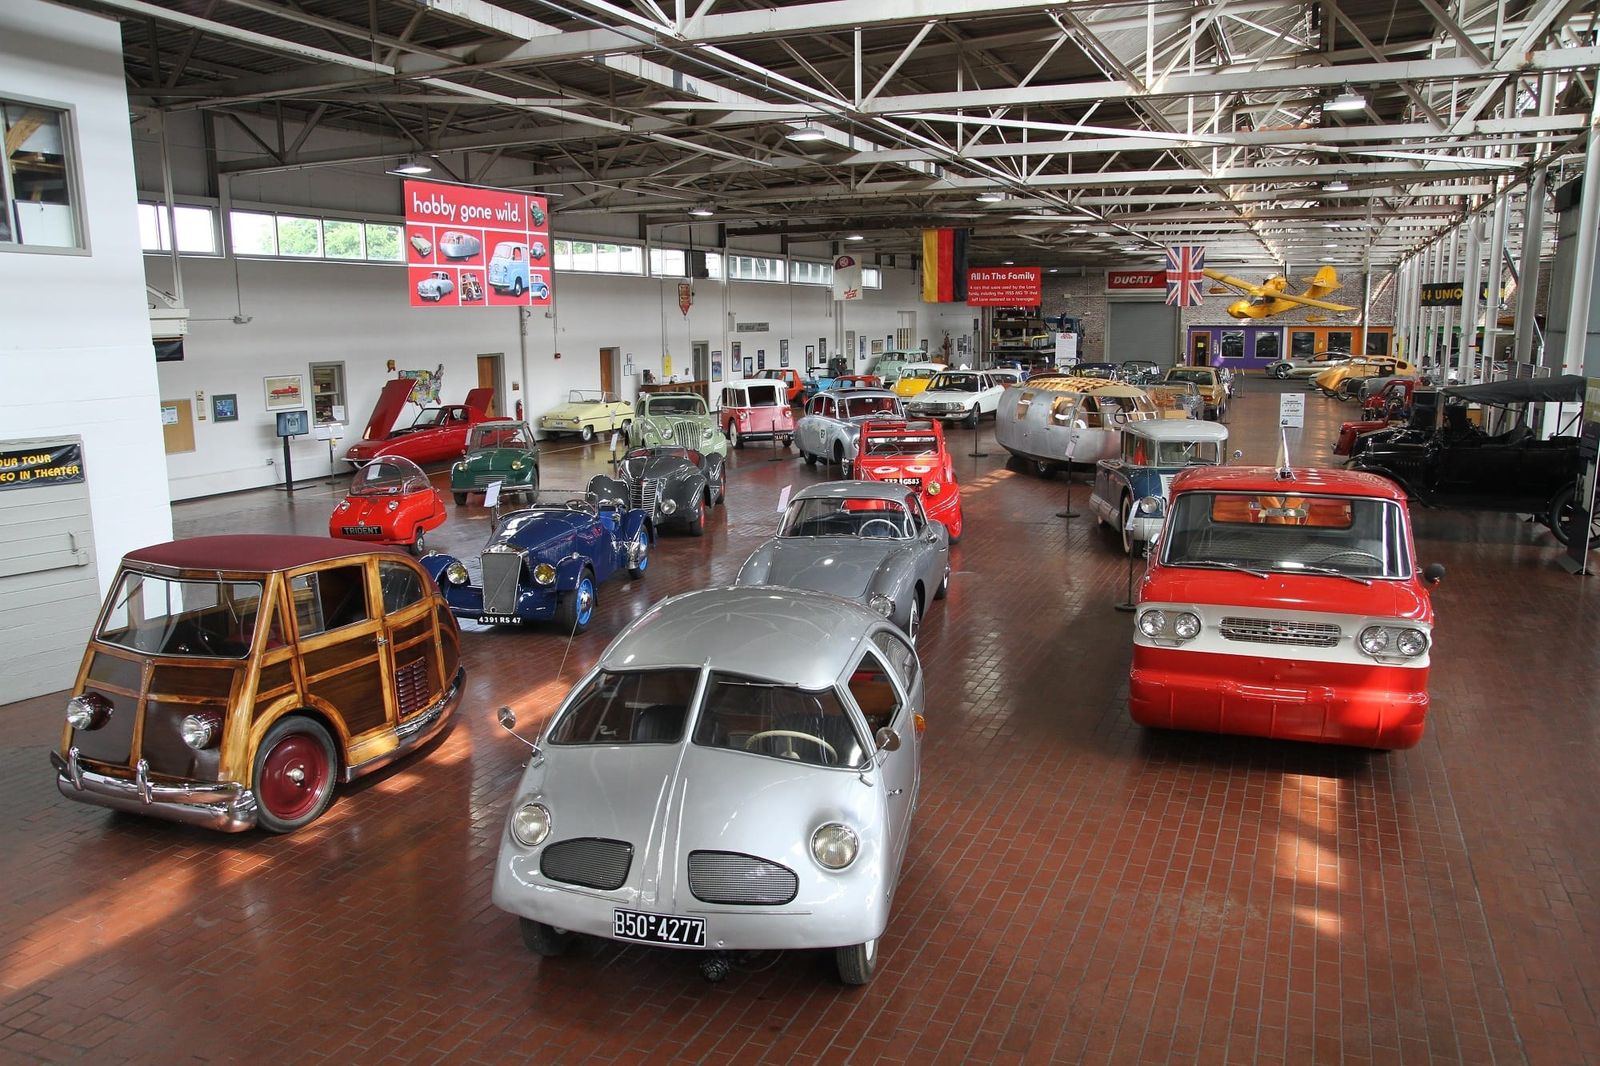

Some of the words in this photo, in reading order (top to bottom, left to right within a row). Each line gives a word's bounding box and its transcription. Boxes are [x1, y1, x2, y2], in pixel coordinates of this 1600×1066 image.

[413, 192, 456, 221] hobby
[461, 204, 492, 222] gone
[495, 202, 521, 222] wild.
[1008, 272, 1034, 281] Family
[1114, 276, 1154, 284] DUCATI
[1436, 288, 1463, 300] UNIQ
[0, 458, 18, 467] UR
[22, 454, 52, 465] TOUR
[20, 471, 30, 480] IN
[34, 466, 79, 478] THEATER
[344, 526, 379, 536] TRIDENT
